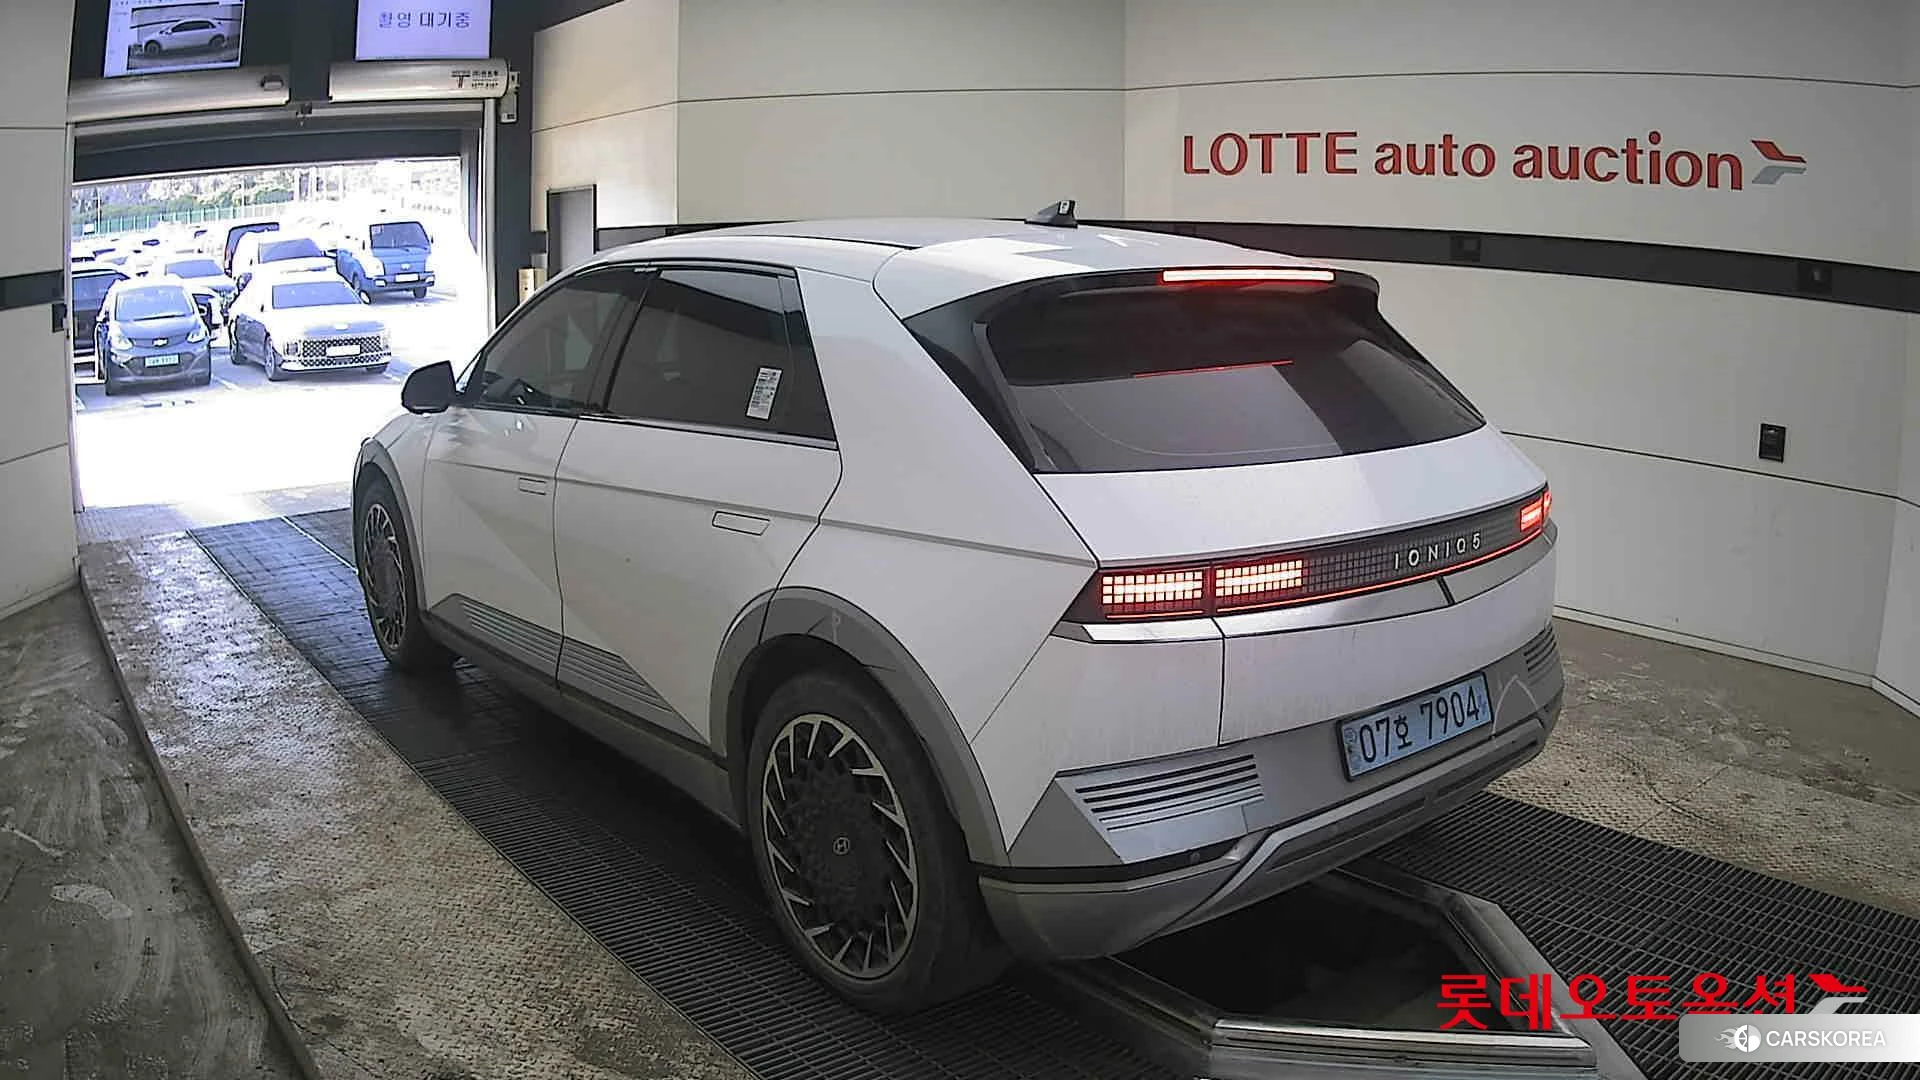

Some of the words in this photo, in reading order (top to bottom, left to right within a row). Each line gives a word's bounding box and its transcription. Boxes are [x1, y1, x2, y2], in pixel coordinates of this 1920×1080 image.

[1183, 131, 1358, 175] LOTTE
[1374, 134, 1496, 177] auto
[1512, 131, 1743, 190] auction
[1359, 715, 1412, 763] 07호
[1420, 686, 1480, 740] 7904
